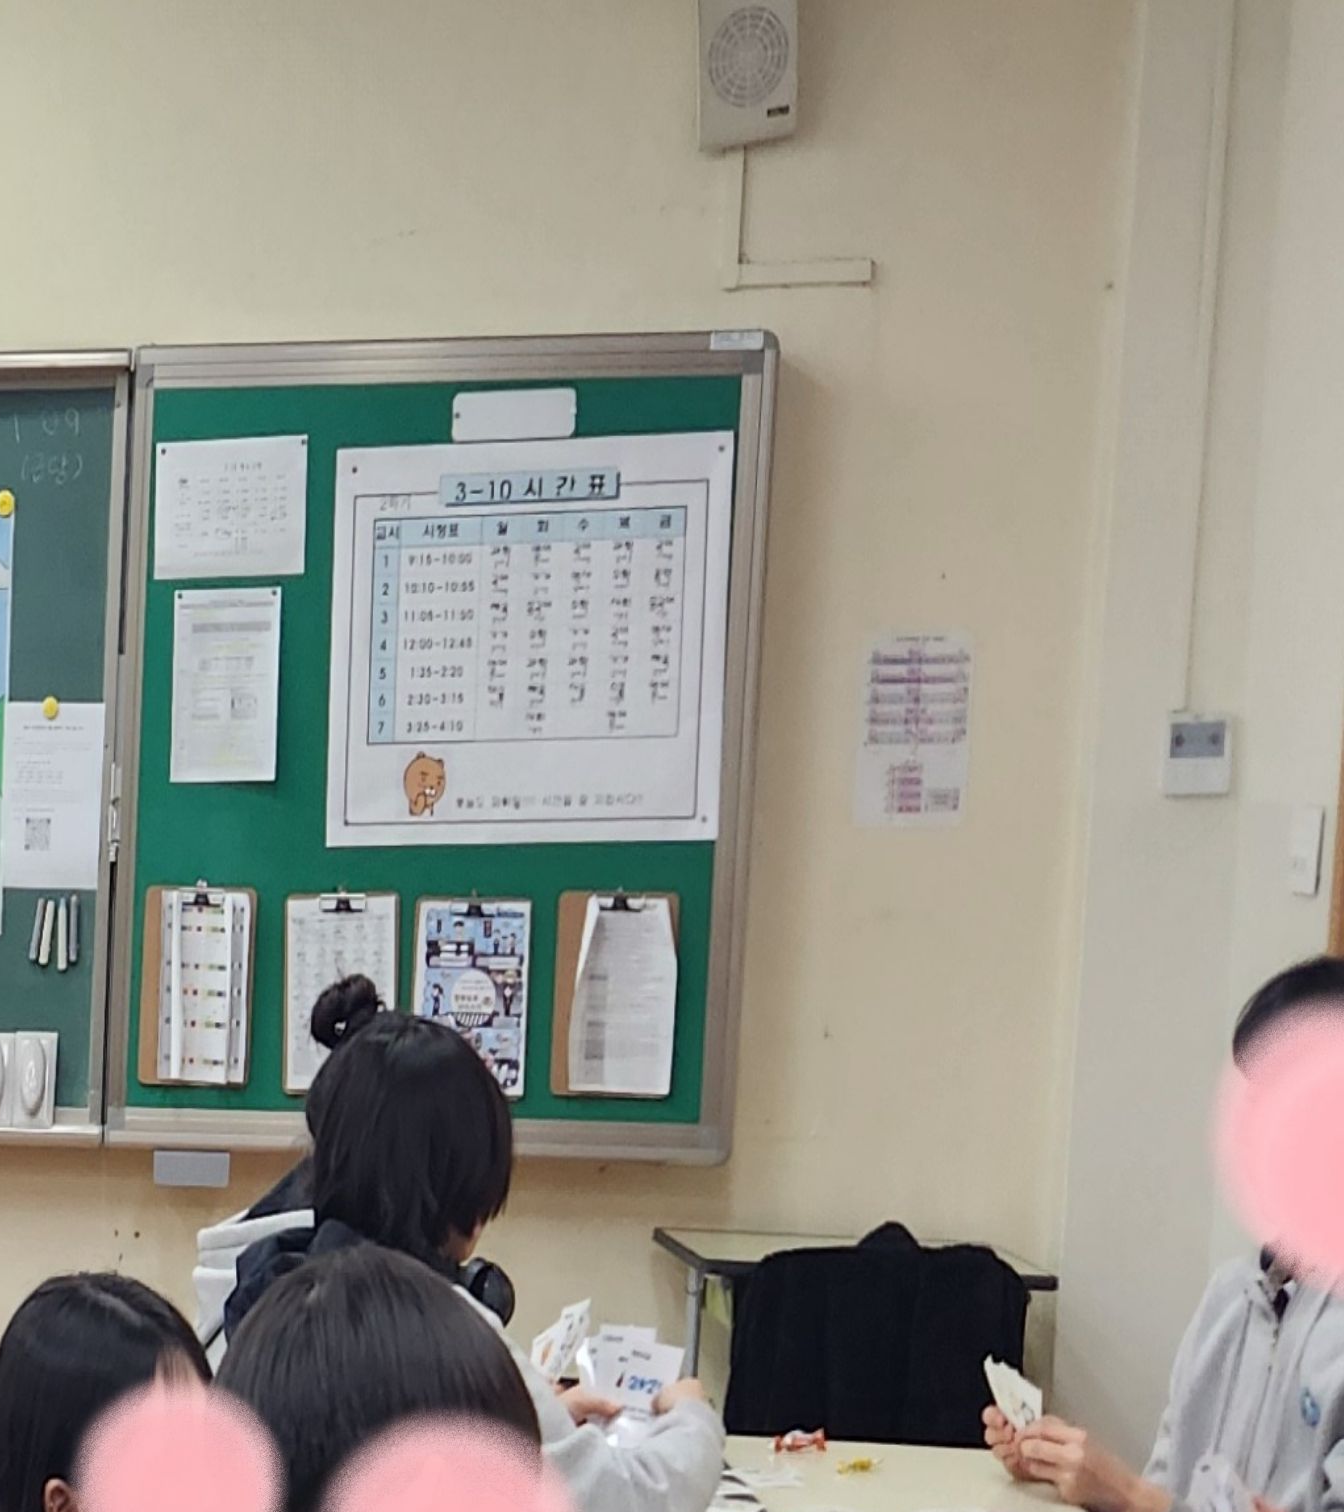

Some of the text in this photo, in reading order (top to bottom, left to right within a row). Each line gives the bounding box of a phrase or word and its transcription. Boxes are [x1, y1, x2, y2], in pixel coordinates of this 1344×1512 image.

[455, 479, 512, 502] 3-10
[578, 518, 588, 530] 수
[383, 556, 389, 568] 1
[382, 583, 389, 596] 2
[381, 611, 388, 623] 3
[380, 639, 386, 651] 4
[379, 668, 386, 680] 5
[378, 694, 385, 706] 6
[378, 722, 384, 734] 7
